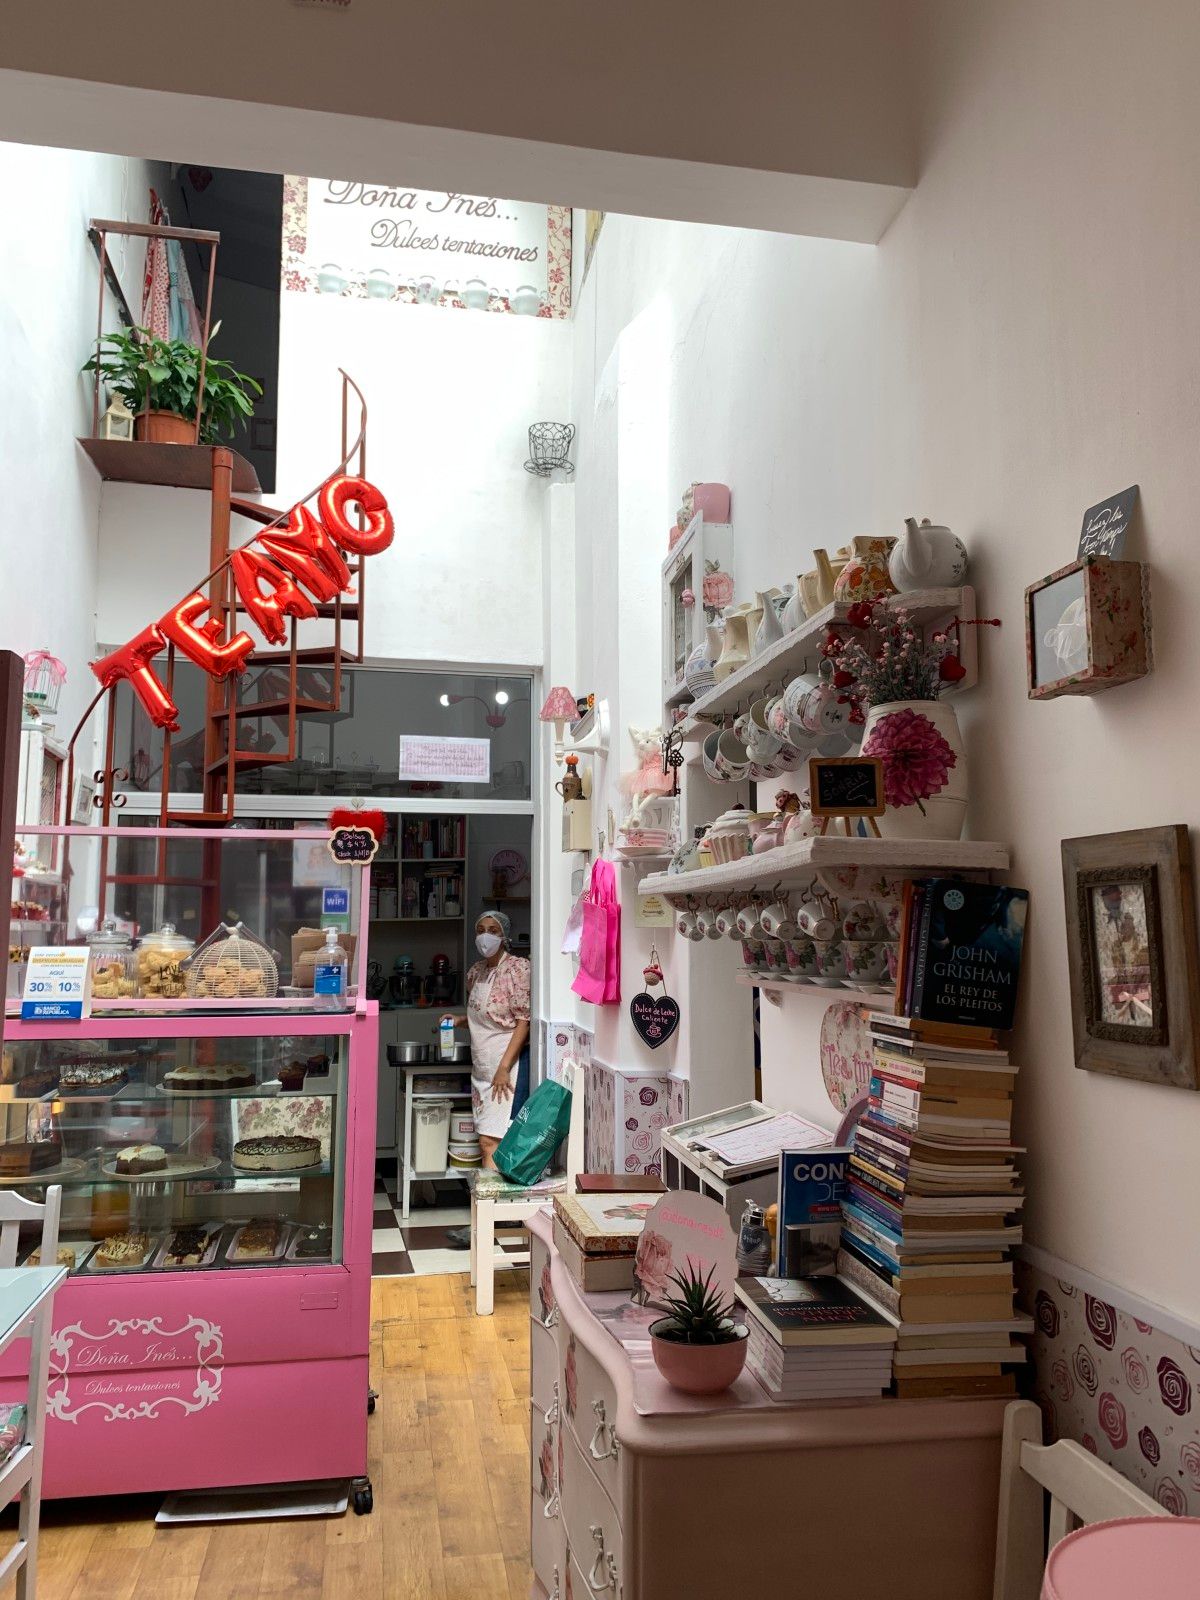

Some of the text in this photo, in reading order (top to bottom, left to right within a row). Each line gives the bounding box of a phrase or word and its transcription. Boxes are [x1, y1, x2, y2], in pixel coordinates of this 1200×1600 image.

[370, 218, 539, 262] Dulces tentaciones
[951, 945, 997, 964] JOHN
[933, 962, 1011, 985] GRISHAM
[944, 983, 998, 999] EL REY DE
[936, 994, 1003, 1012] LOS PLEITOS
[793, 1162, 849, 1182] CON
[75, 1345, 129, 1366] Doña
[84, 1380, 181, 1396] Dulces tentaciones
